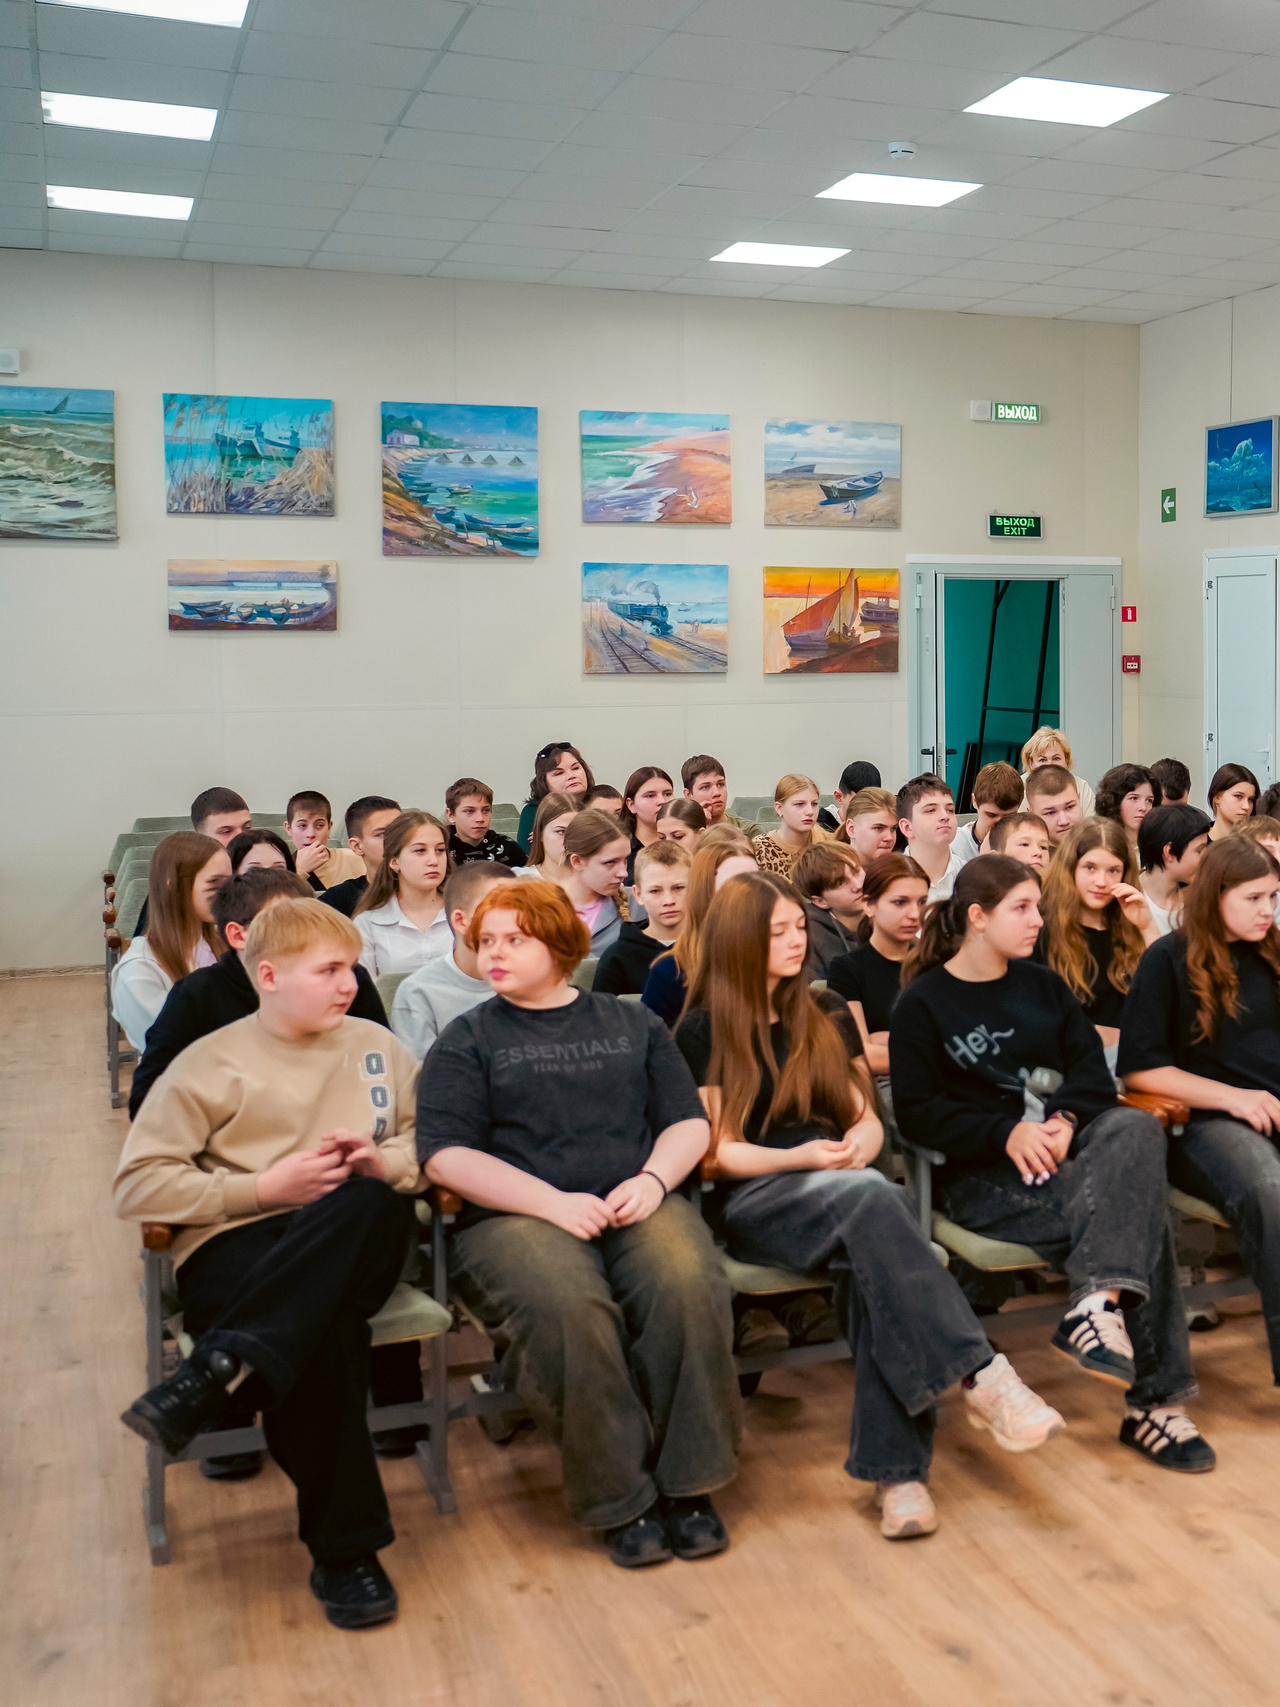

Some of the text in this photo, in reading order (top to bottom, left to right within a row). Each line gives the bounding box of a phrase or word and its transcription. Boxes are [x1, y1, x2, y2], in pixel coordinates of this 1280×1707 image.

[997, 404, 1037, 421] ВЫХОД
[995, 517, 1035, 528] ВЫХОД
[1003, 527, 1028, 536] EXIT
[494, 1036, 633, 1070] ESSENTIALS
